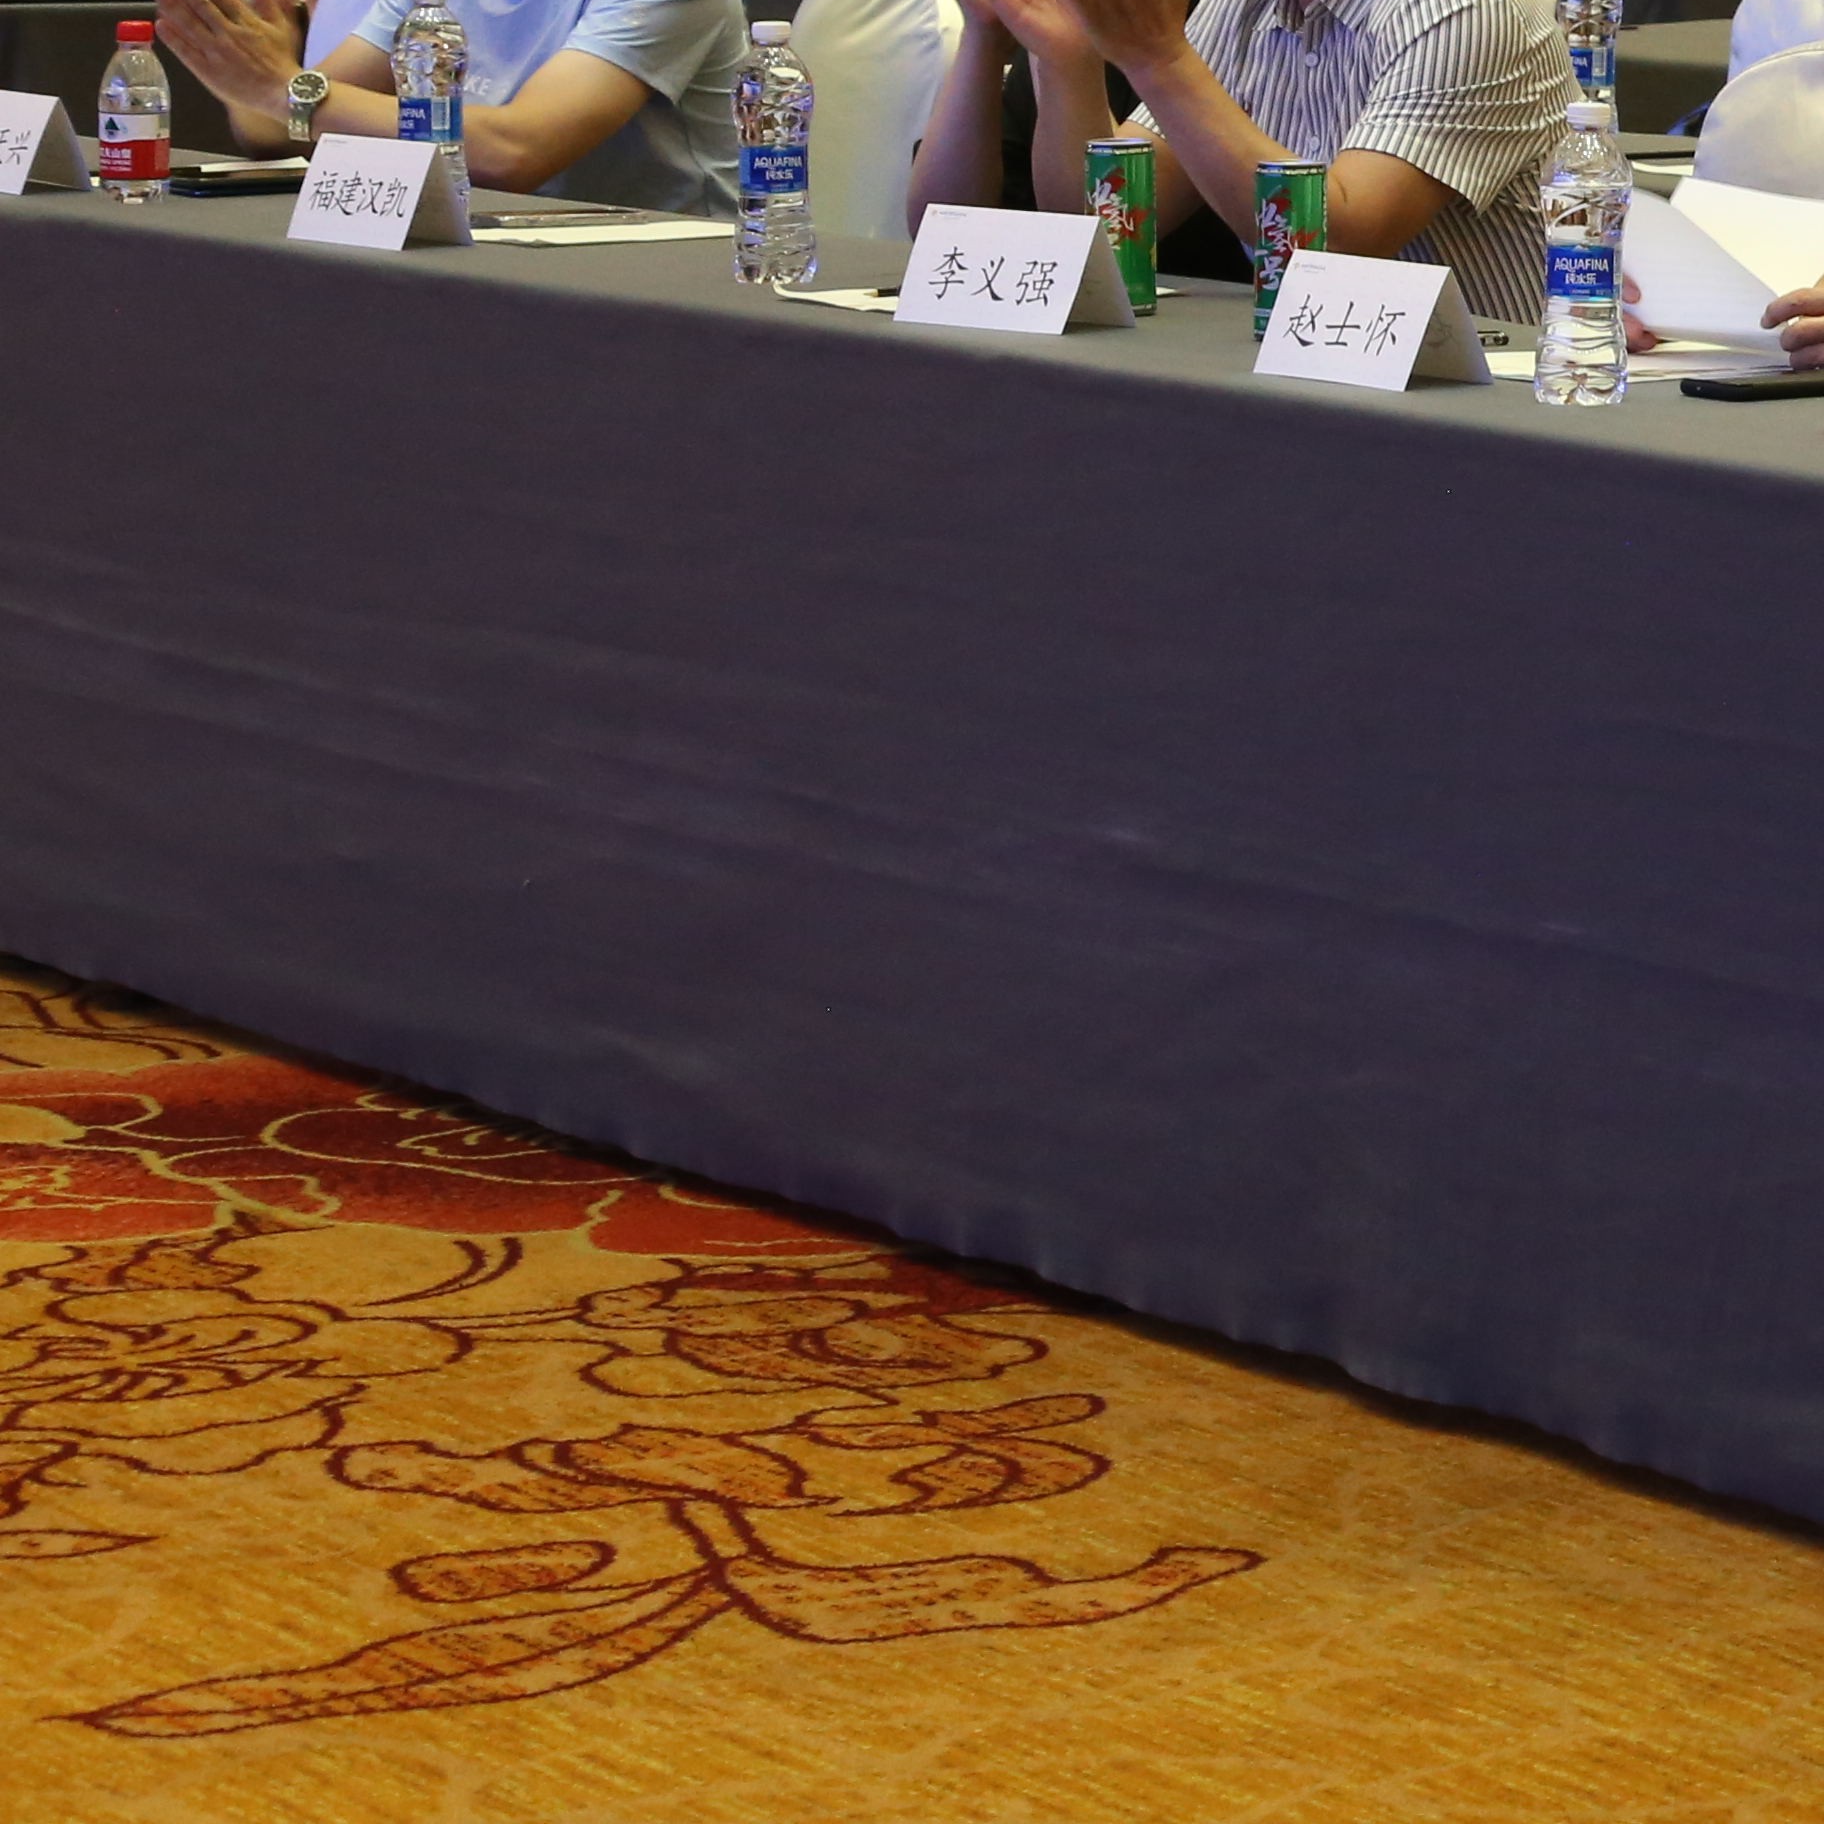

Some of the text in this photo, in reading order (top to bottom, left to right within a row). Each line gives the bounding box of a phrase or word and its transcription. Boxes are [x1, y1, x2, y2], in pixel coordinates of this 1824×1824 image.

[309, 171, 406, 219] 福建汉凯
[928, 245, 1059, 307] 李义强
[1553, 256, 1610, 273] AQUAFINA
[1283, 293, 1407, 357] 赵士怀
